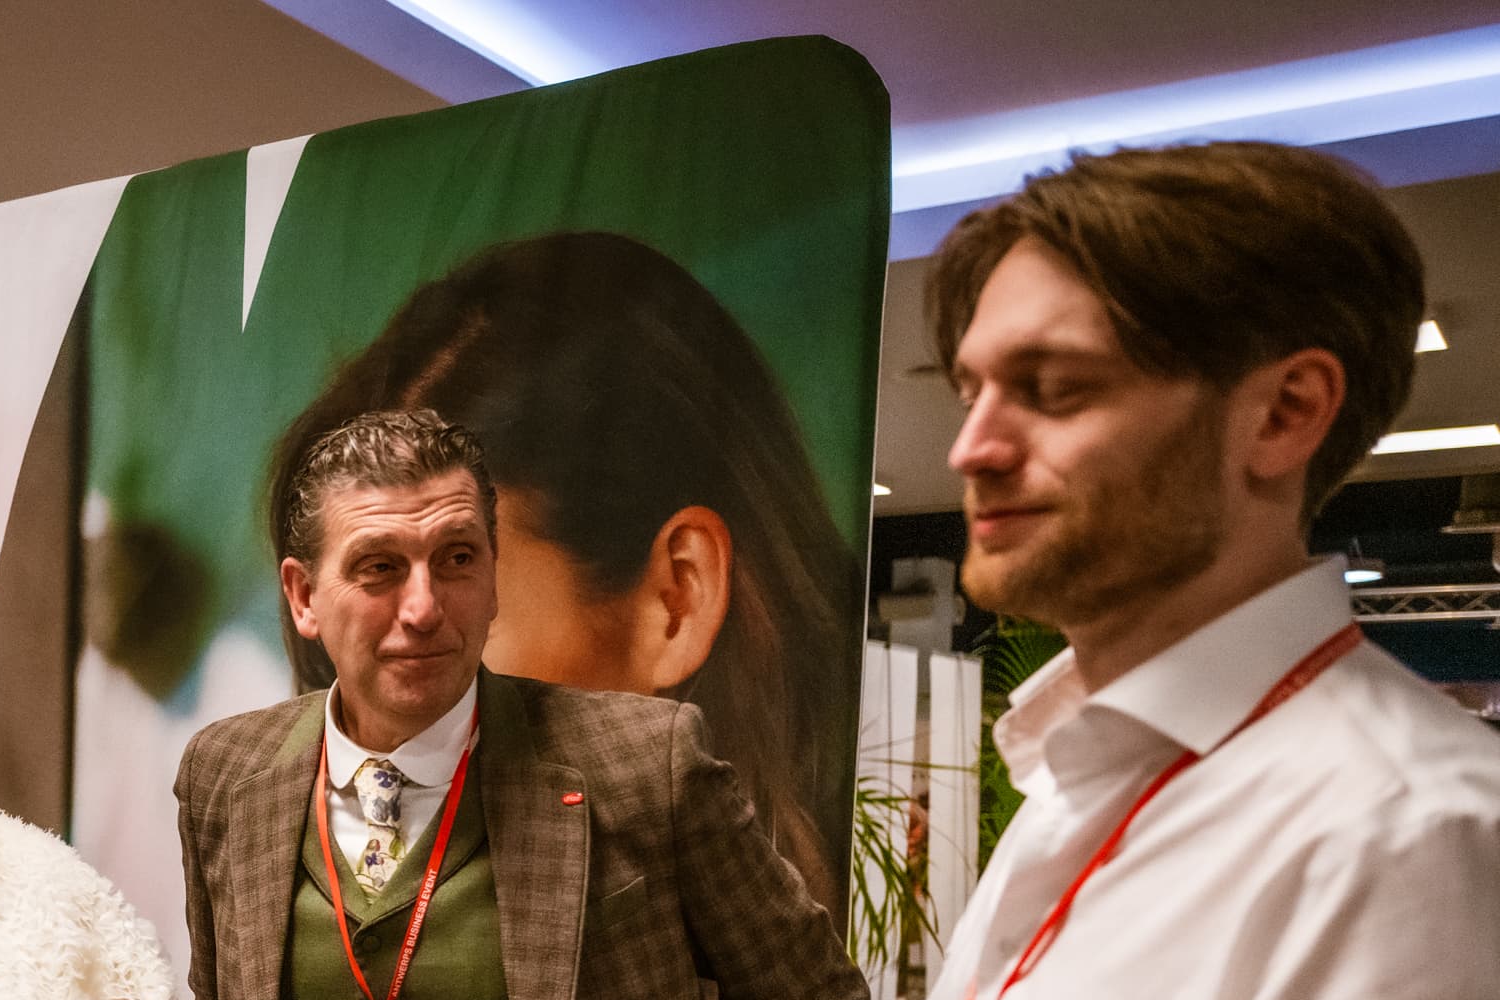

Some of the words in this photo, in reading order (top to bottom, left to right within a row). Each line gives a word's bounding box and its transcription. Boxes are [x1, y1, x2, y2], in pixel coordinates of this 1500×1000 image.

[391, 947, 413, 998] ANTWERPS
[406, 901, 428, 947] BUSINESS
[421, 868, 438, 900] EVENT
